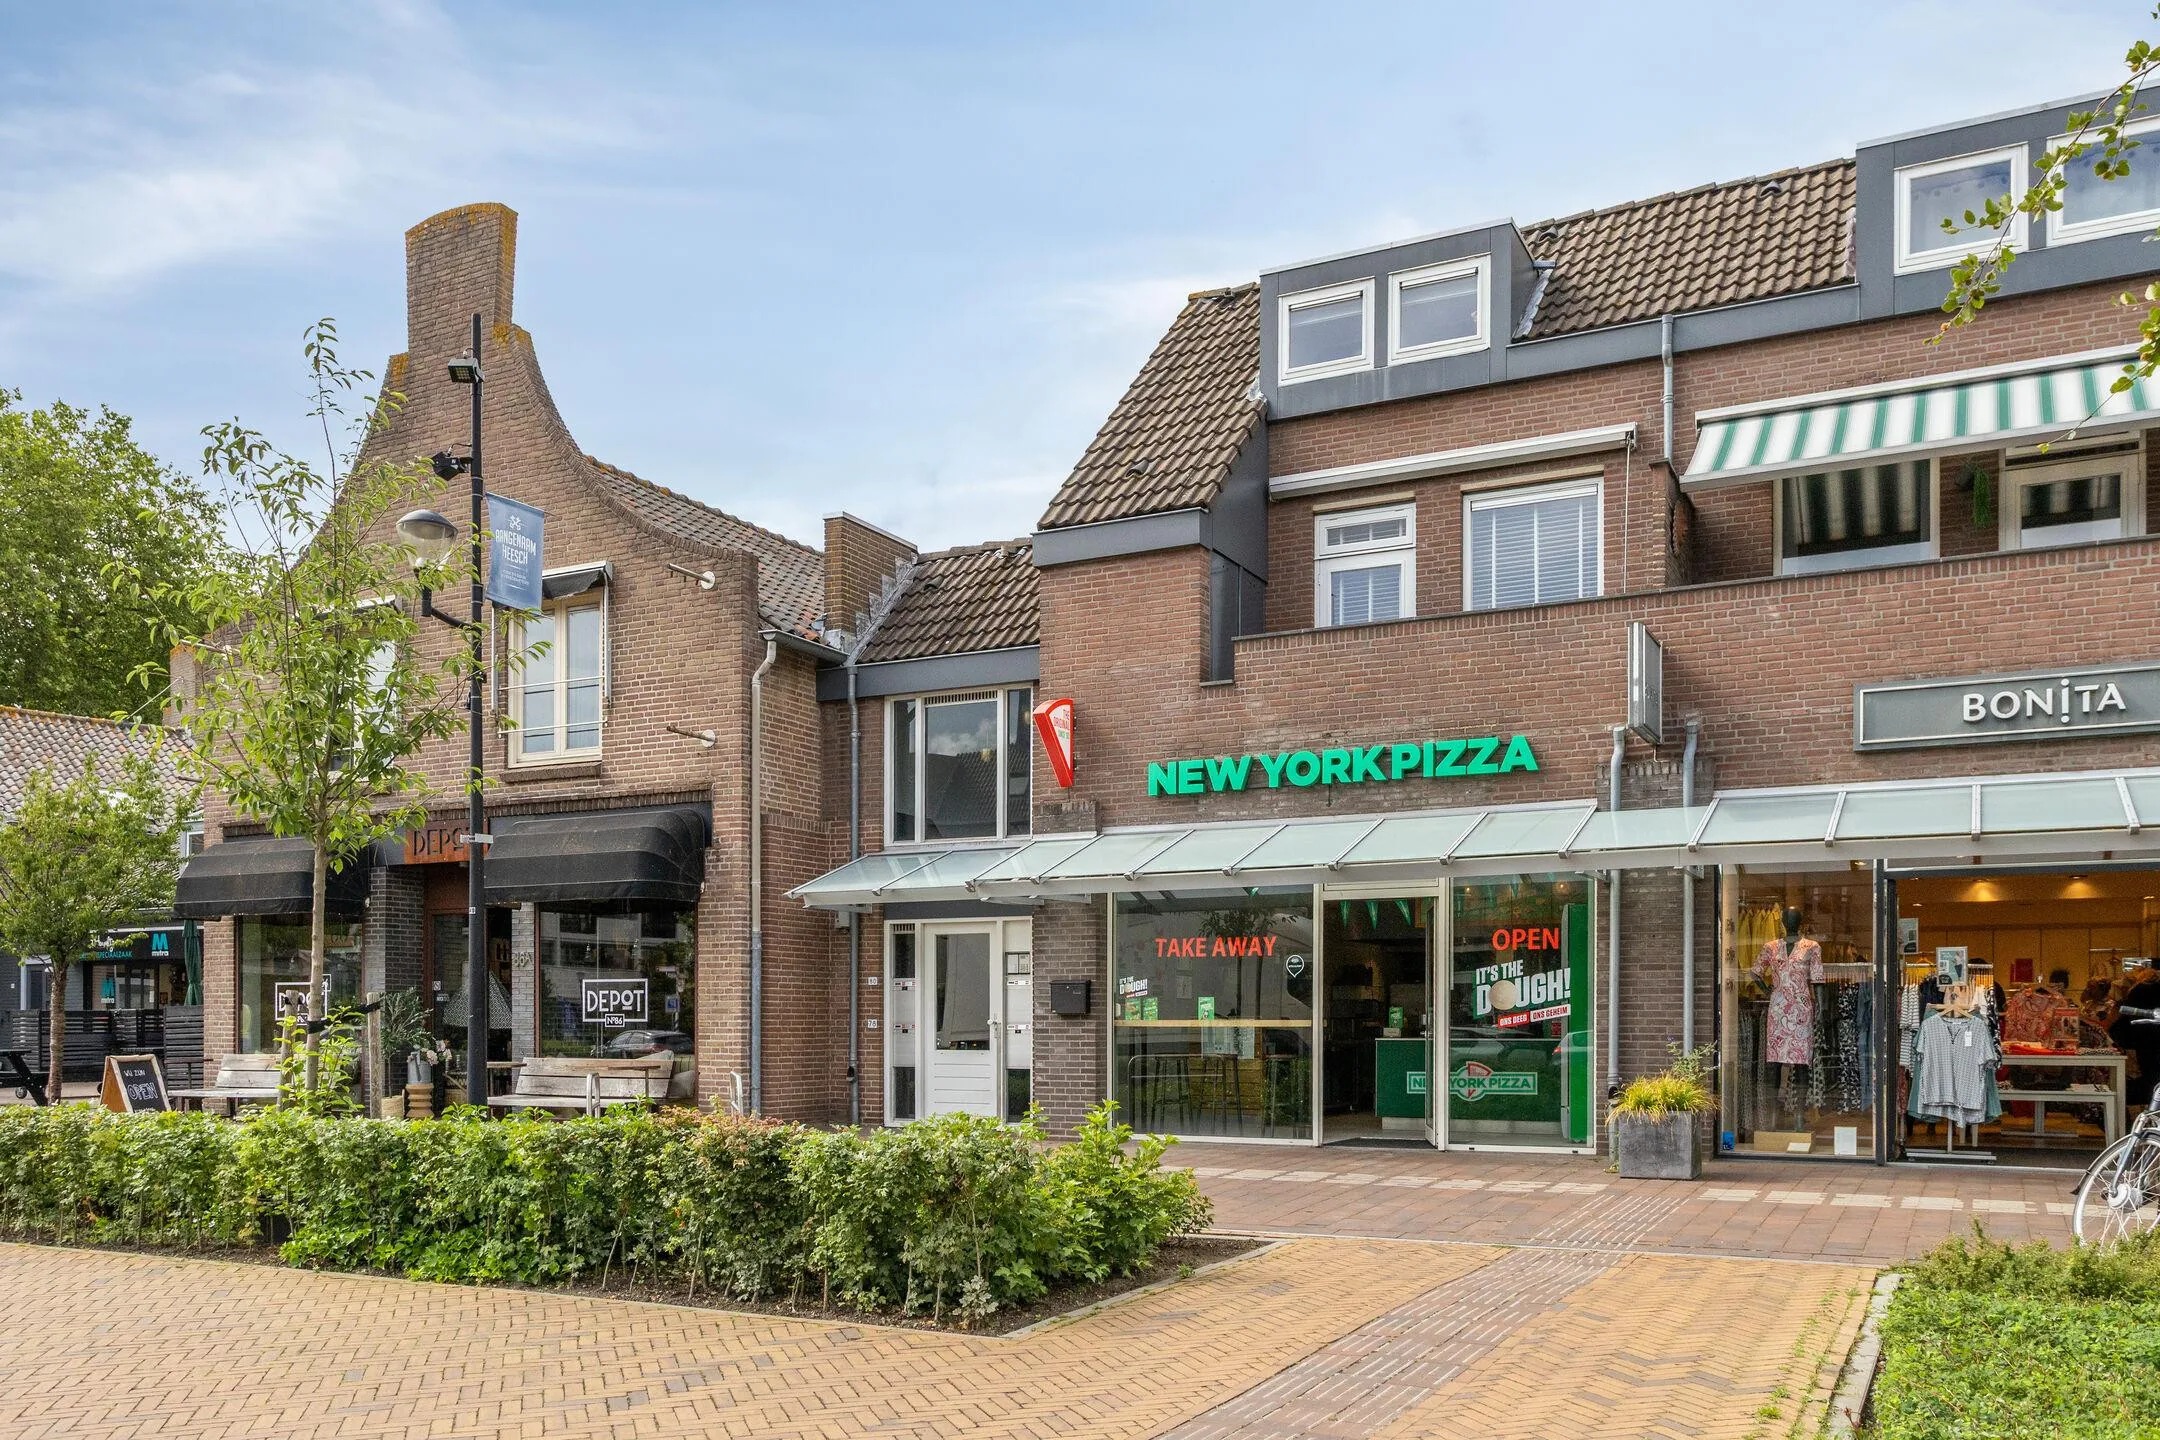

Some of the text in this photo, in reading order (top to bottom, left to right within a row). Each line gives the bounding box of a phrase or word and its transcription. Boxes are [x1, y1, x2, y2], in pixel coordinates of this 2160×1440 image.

[495, 529, 537, 556] AANGENAAM
[502, 544, 528, 564] HEESCH
[1147, 735, 1540, 797] NEW YORK PIZZA
[413, 827, 471, 856] DEPO
[1155, 935, 1277, 958] TAKE AWAY
[1492, 927, 1559, 951] OPEN
[1475, 959, 1524, 985] IT'S THE
[586, 989, 645, 1012] DEPOT
[1531, 1011, 1545, 1020] ONS
[1489, 1077, 1531, 1089] PIZZA
